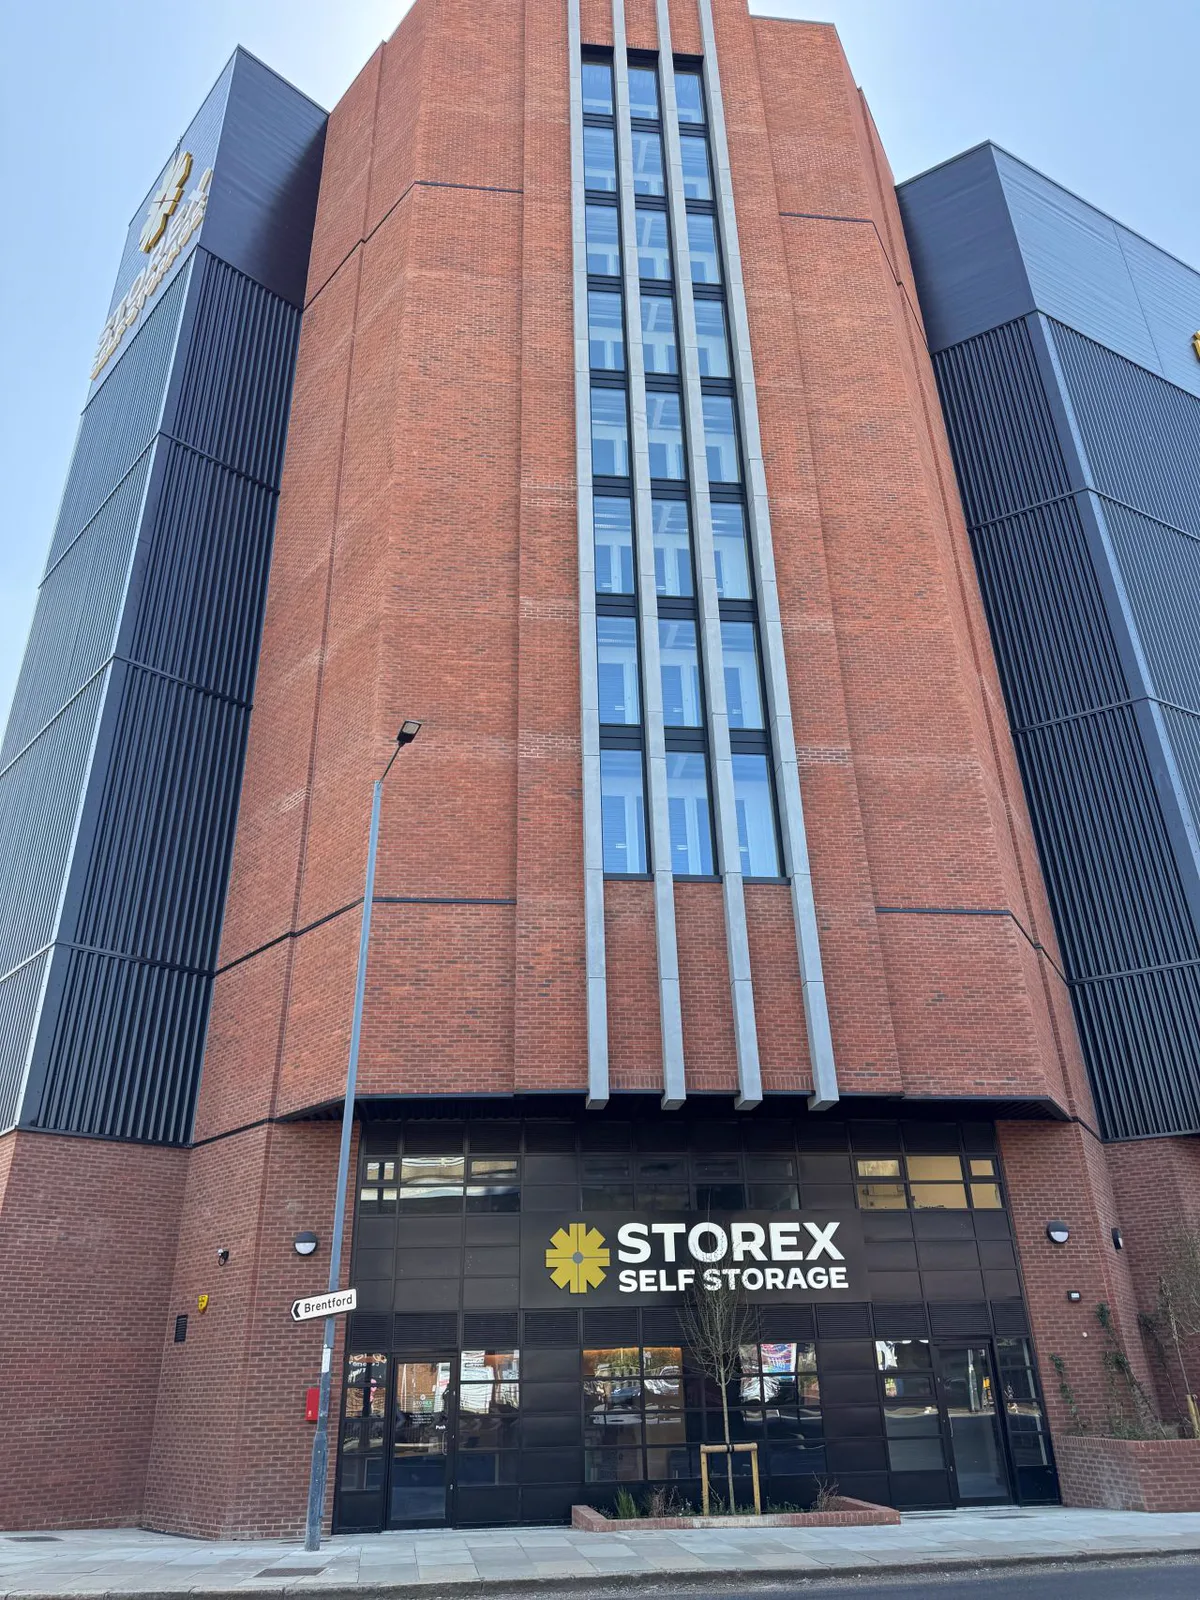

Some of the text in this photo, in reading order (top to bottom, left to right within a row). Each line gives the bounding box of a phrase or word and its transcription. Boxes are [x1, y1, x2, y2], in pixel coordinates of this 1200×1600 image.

[617, 1221, 846, 1264] STOREX
[618, 1266, 849, 1293] SELF STORAGE
[304, 1294, 353, 1313] Brentford
